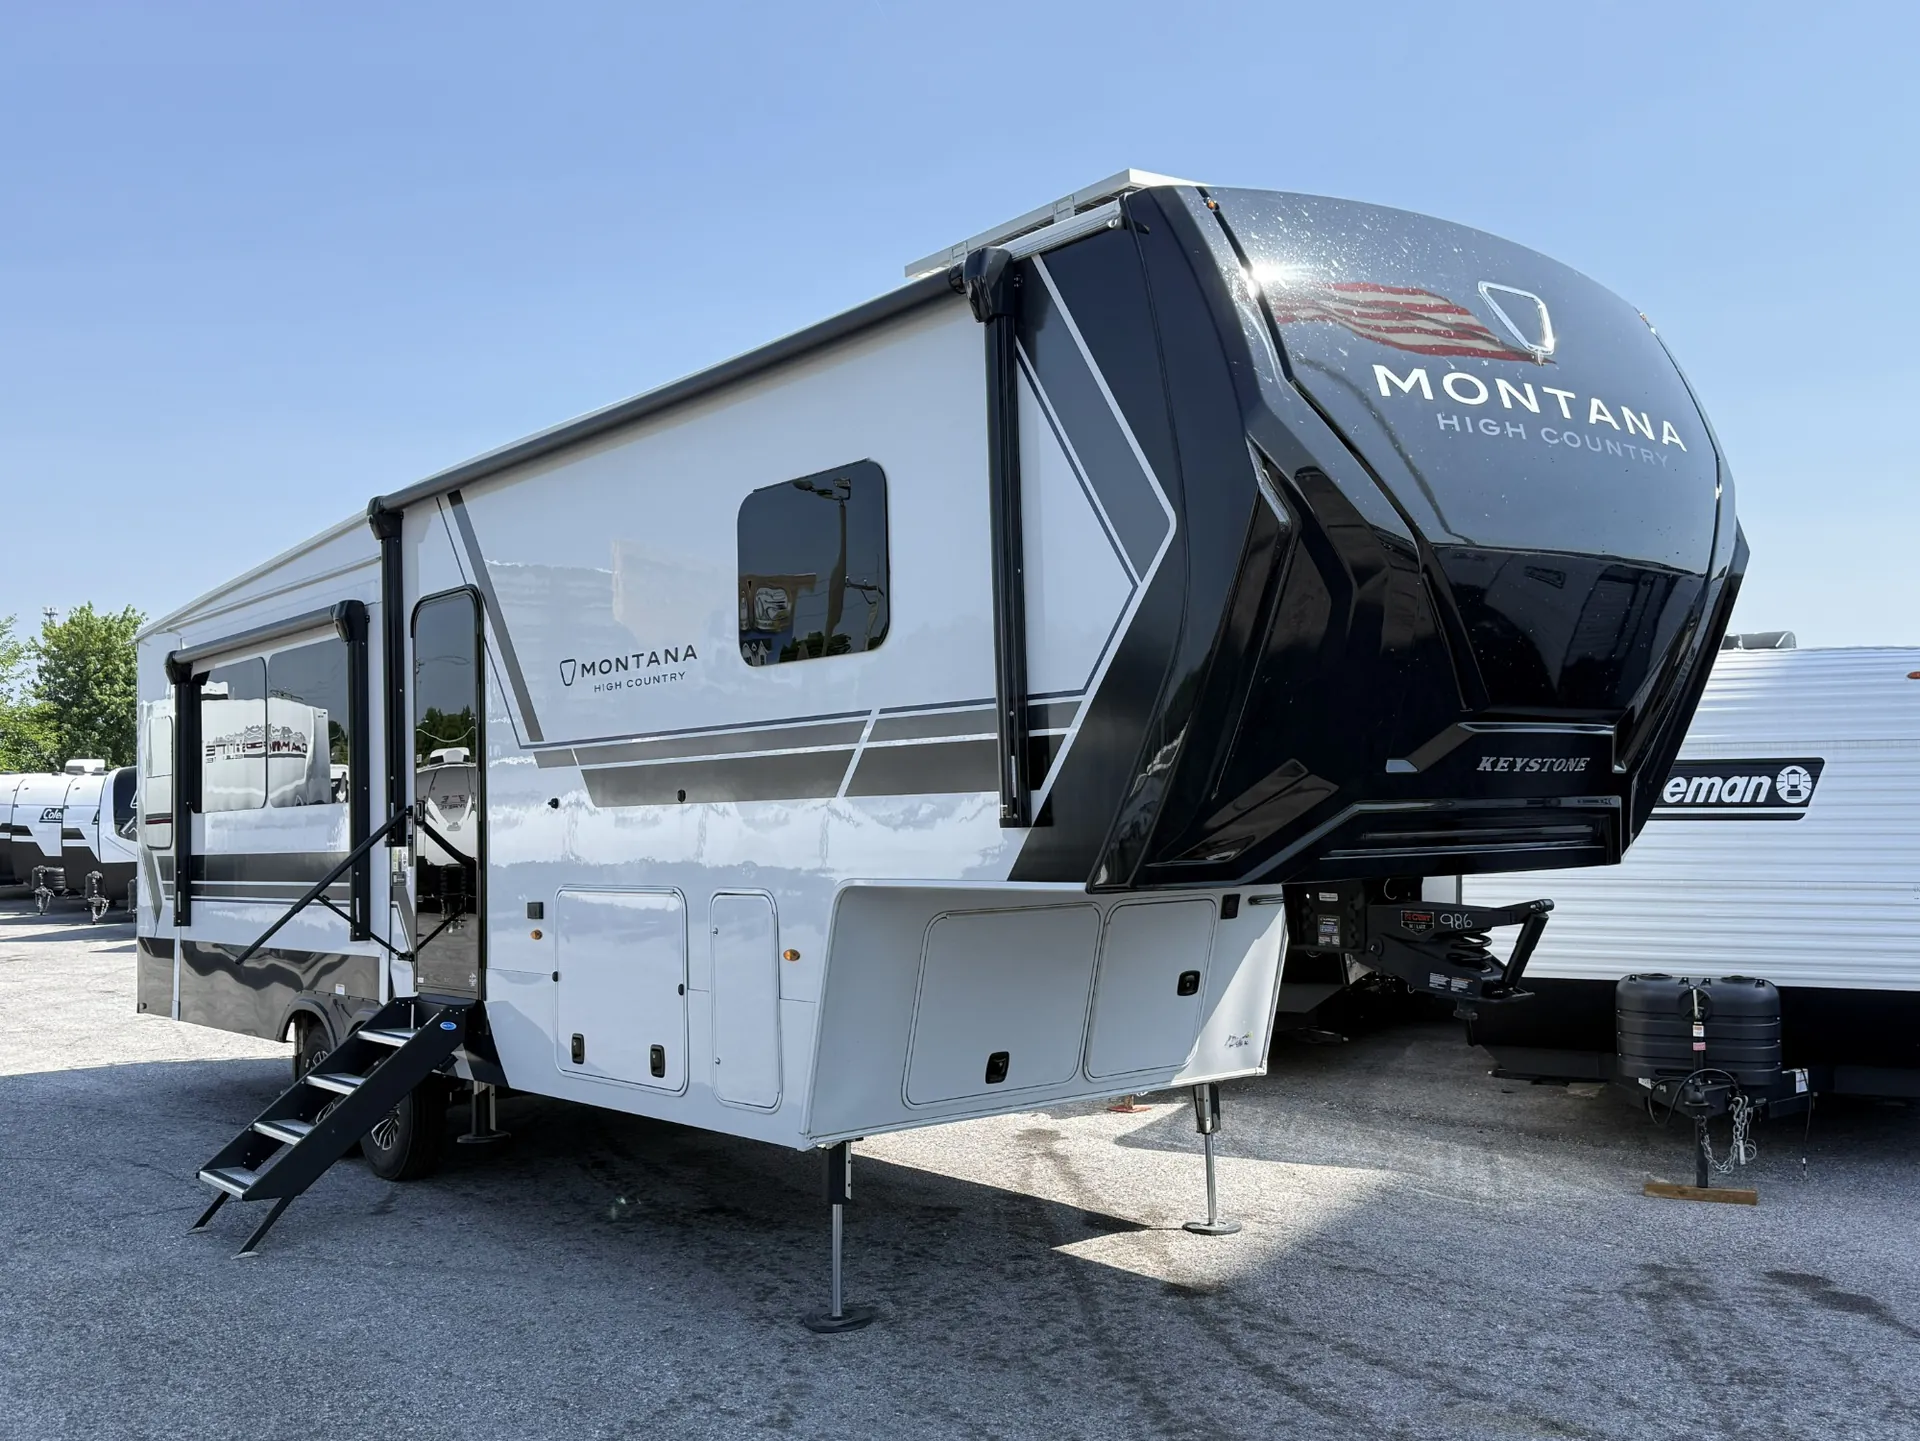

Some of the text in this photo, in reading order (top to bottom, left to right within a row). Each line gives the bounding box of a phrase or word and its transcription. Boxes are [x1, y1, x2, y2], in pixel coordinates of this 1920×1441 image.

[1372, 364, 1687, 452] MONTANA
[1437, 412, 1669, 468] HIGH COUNTRY
[581, 644, 697, 677] MONTANA
[594, 671, 686, 692] HIGH COUNTRY
[1476, 756, 1590, 772] KEYSTONE
[1662, 775, 1772, 804] eman
[1440, 913, 1473, 930] 986
